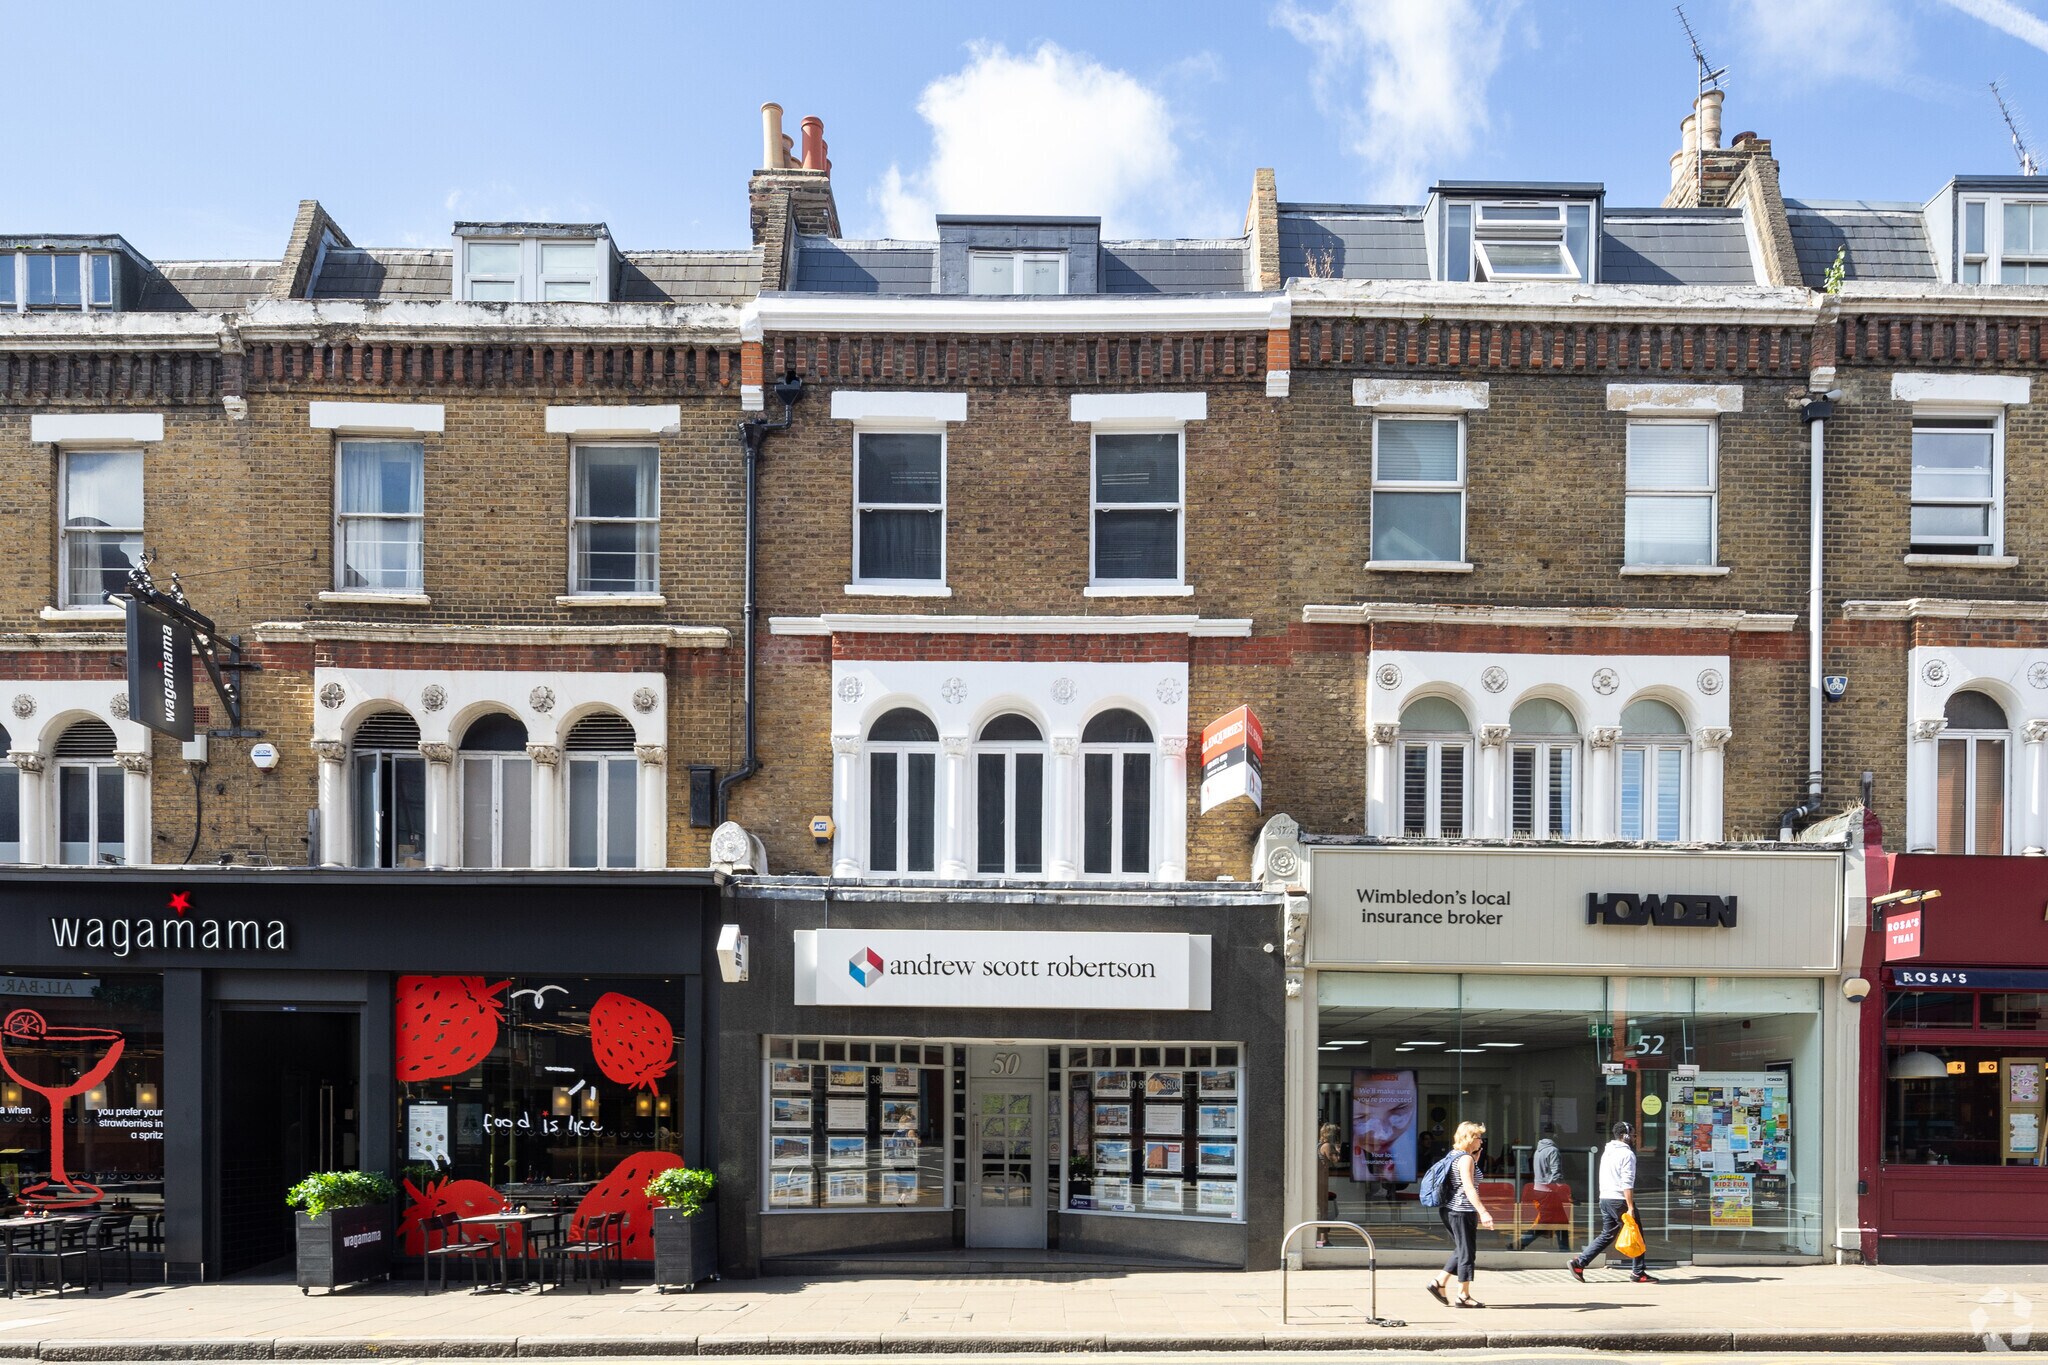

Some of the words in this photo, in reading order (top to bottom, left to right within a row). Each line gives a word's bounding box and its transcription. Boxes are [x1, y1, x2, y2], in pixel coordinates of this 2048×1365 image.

[162, 624, 177, 722] wagamama
[1356, 888, 1467, 905] Wimbledon's
[1471, 890, 1511, 906] local
[1361, 909, 1443, 924] insurance
[1447, 909, 1503, 925] broker
[1585, 892, 1738, 929] HOWDEN
[1887, 917, 1920, 932] ROSA'S
[51, 917, 286, 957] wagamama
[1892, 932, 1914, 945] THAI
[890, 953, 976, 976] andrew
[982, 958, 1040, 977] scott
[1046, 955, 1156, 978] robertson
[1902, 971, 1967, 984] ROSA'S
[1635, 1034, 1665, 1055] 52
[990, 1052, 1021, 1076] 50
[1379, 1096, 1412, 1104] protected
[7, 1106, 32, 1115] when
[97, 1108, 114, 1117] you
[115, 1107, 142, 1118] prefer
[143, 1109, 164, 1118] your
[98, 1118, 153, 1128] strawberries
[155, 1118, 164, 1128] in
[483, 1111, 531, 1134] food
[543, 1114, 559, 1134] is
[138, 1130, 164, 1141] spritz
[343, 1230, 382, 1248] wagamama
